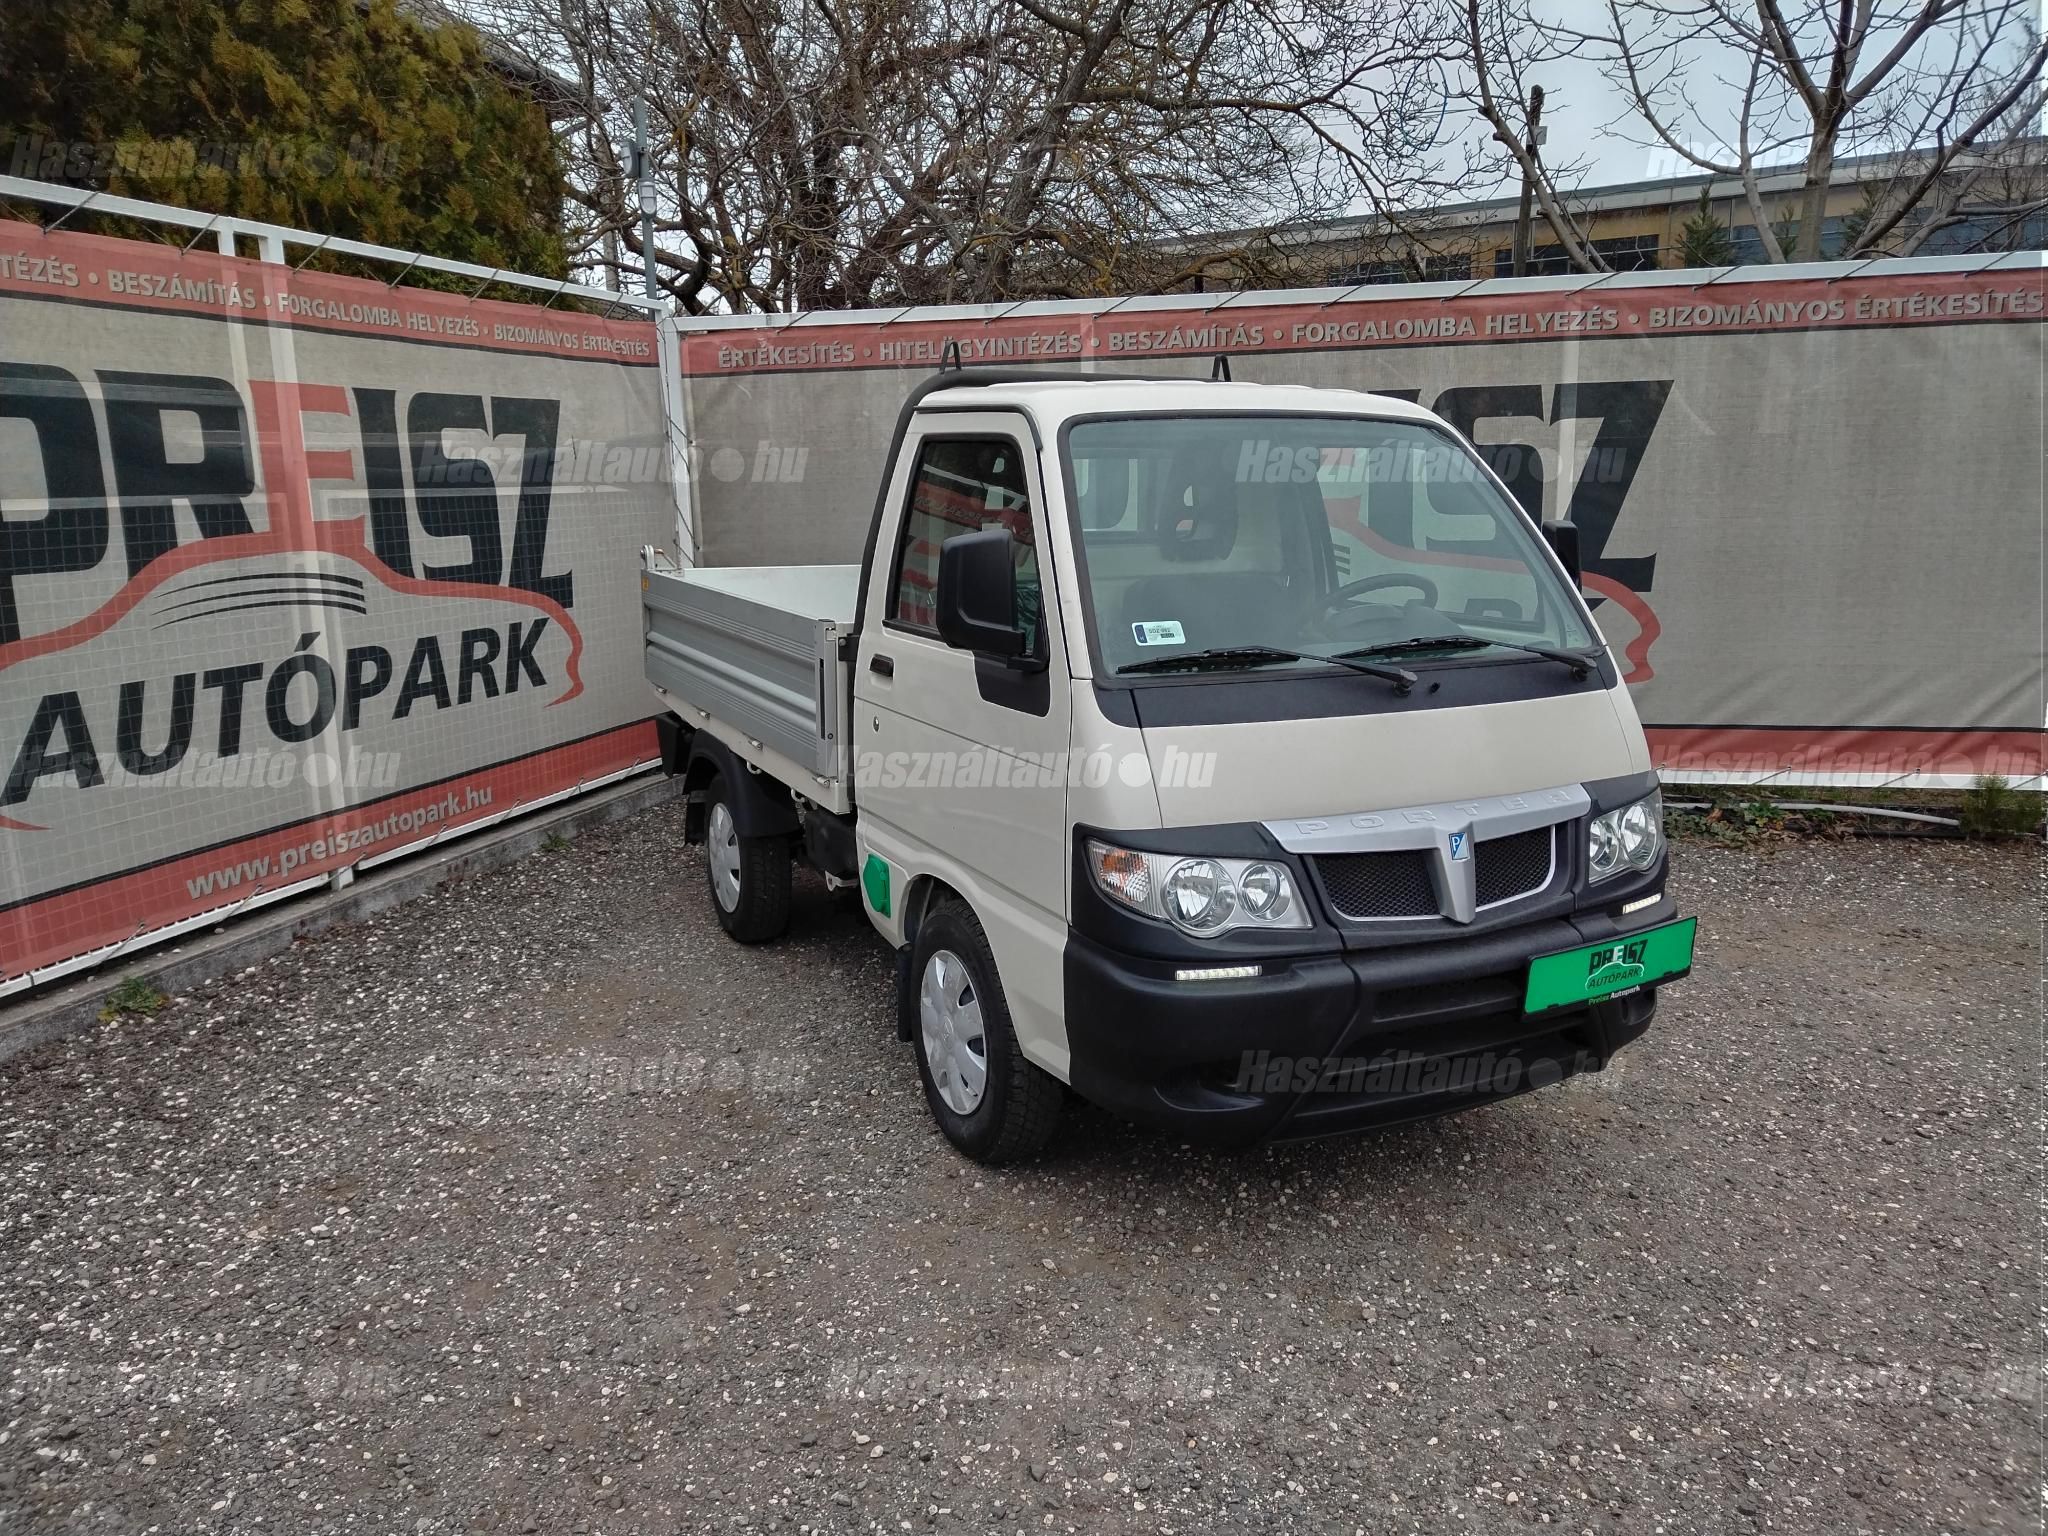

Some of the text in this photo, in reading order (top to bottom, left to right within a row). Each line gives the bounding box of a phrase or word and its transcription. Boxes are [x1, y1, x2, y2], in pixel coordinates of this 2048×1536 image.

[107, 269, 257, 310] BESZÁMÍTÁS
[278, 292, 402, 329] FORGALOMBA
[406, 311, 479, 338] HELYEZÉS
[494, 322, 579, 350] BIZOMÁNYOS
[718, 340, 856, 369] ÉRTÉKESÍTÉS
[1108, 322, 1264, 352] BESZÁMÍTÁS
[1291, 315, 1477, 344] FORGALOMBA
[1484, 305, 1620, 336] HELYEZÉS
[1650, 299, 1845, 329] BIZOMÁNYOS
[1855, 287, 2045, 320] ÉRTÉKESÍTÉS
[0, 360, 574, 643] PREISZ
[0, 617, 549, 803] AUTÓPARK
[187, 786, 493, 900] www.preiszautopark.hu
[1295, 789, 1571, 835] PORTER
[1589, 939, 1648, 976] PREISZ
